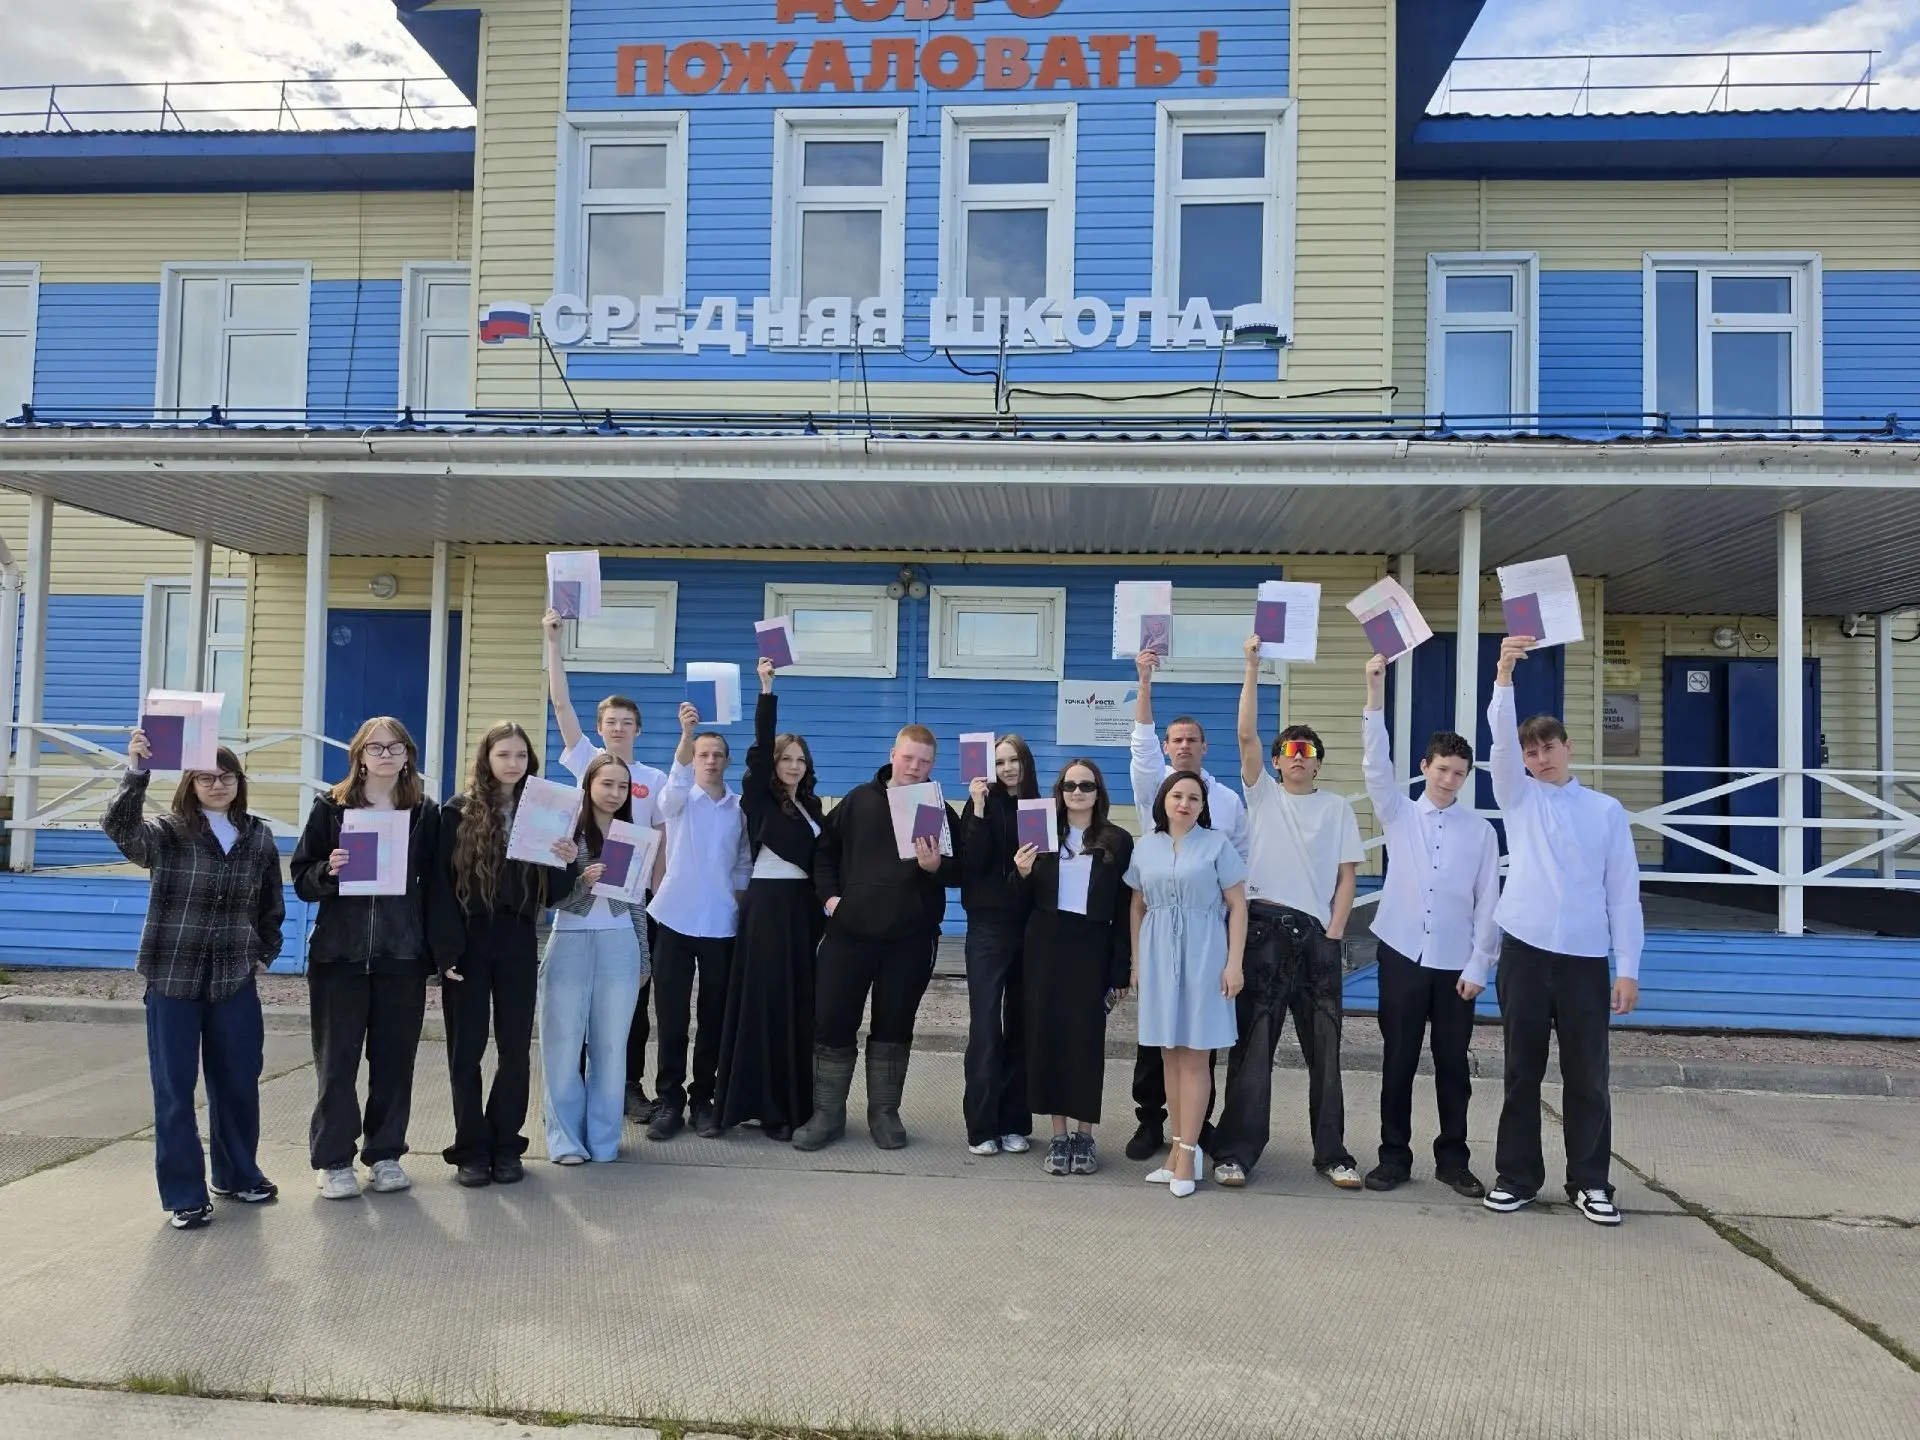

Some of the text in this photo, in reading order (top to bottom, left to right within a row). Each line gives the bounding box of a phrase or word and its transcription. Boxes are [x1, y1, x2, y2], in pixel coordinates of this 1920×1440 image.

[616, 31, 1220, 97] ПОЖАЛОВАТЬ!
[541, 293, 1225, 355] СРЕДНЯЯ ШКОЛА
